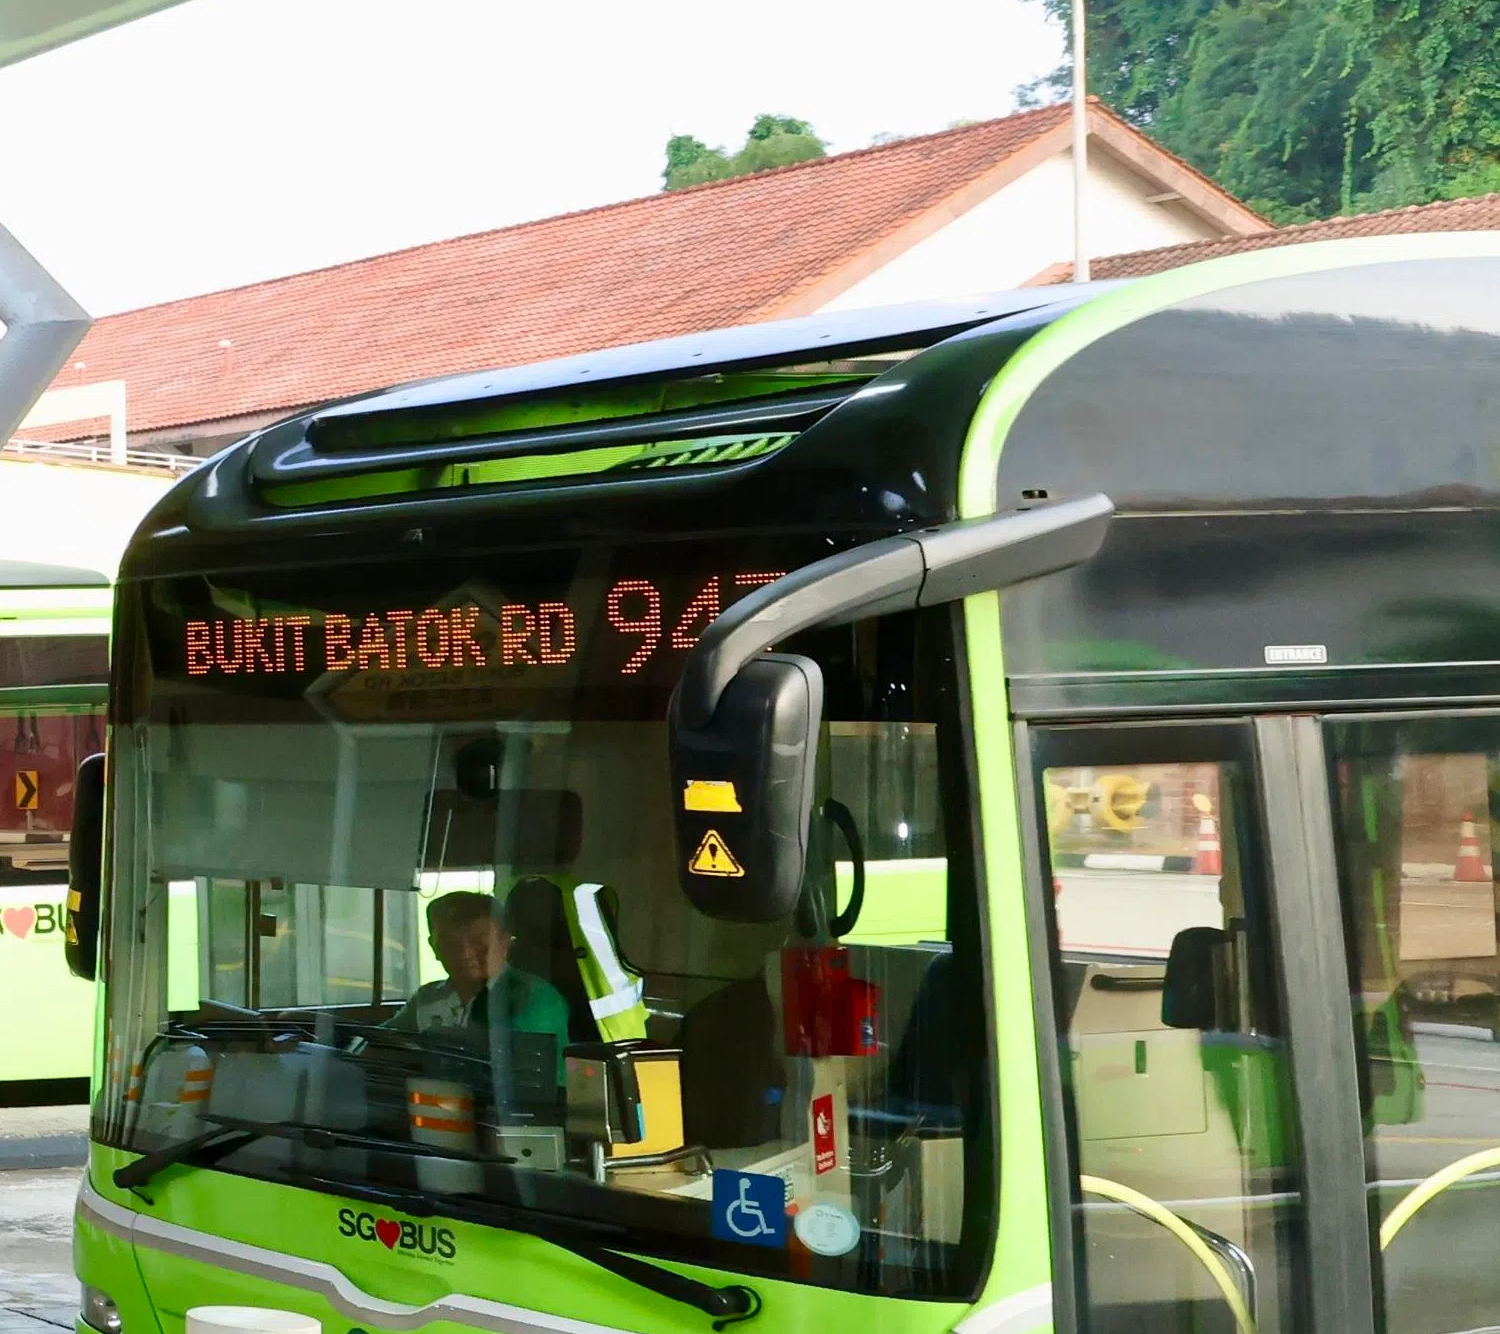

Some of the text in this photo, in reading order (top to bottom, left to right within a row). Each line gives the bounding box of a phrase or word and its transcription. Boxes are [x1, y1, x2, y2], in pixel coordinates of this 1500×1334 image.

[185, 614, 311, 675] BUKIT
[324, 606, 488, 671] BATOK
[500, 601, 577, 666] RD
[1269, 648, 1322, 661] ENTRANCE
